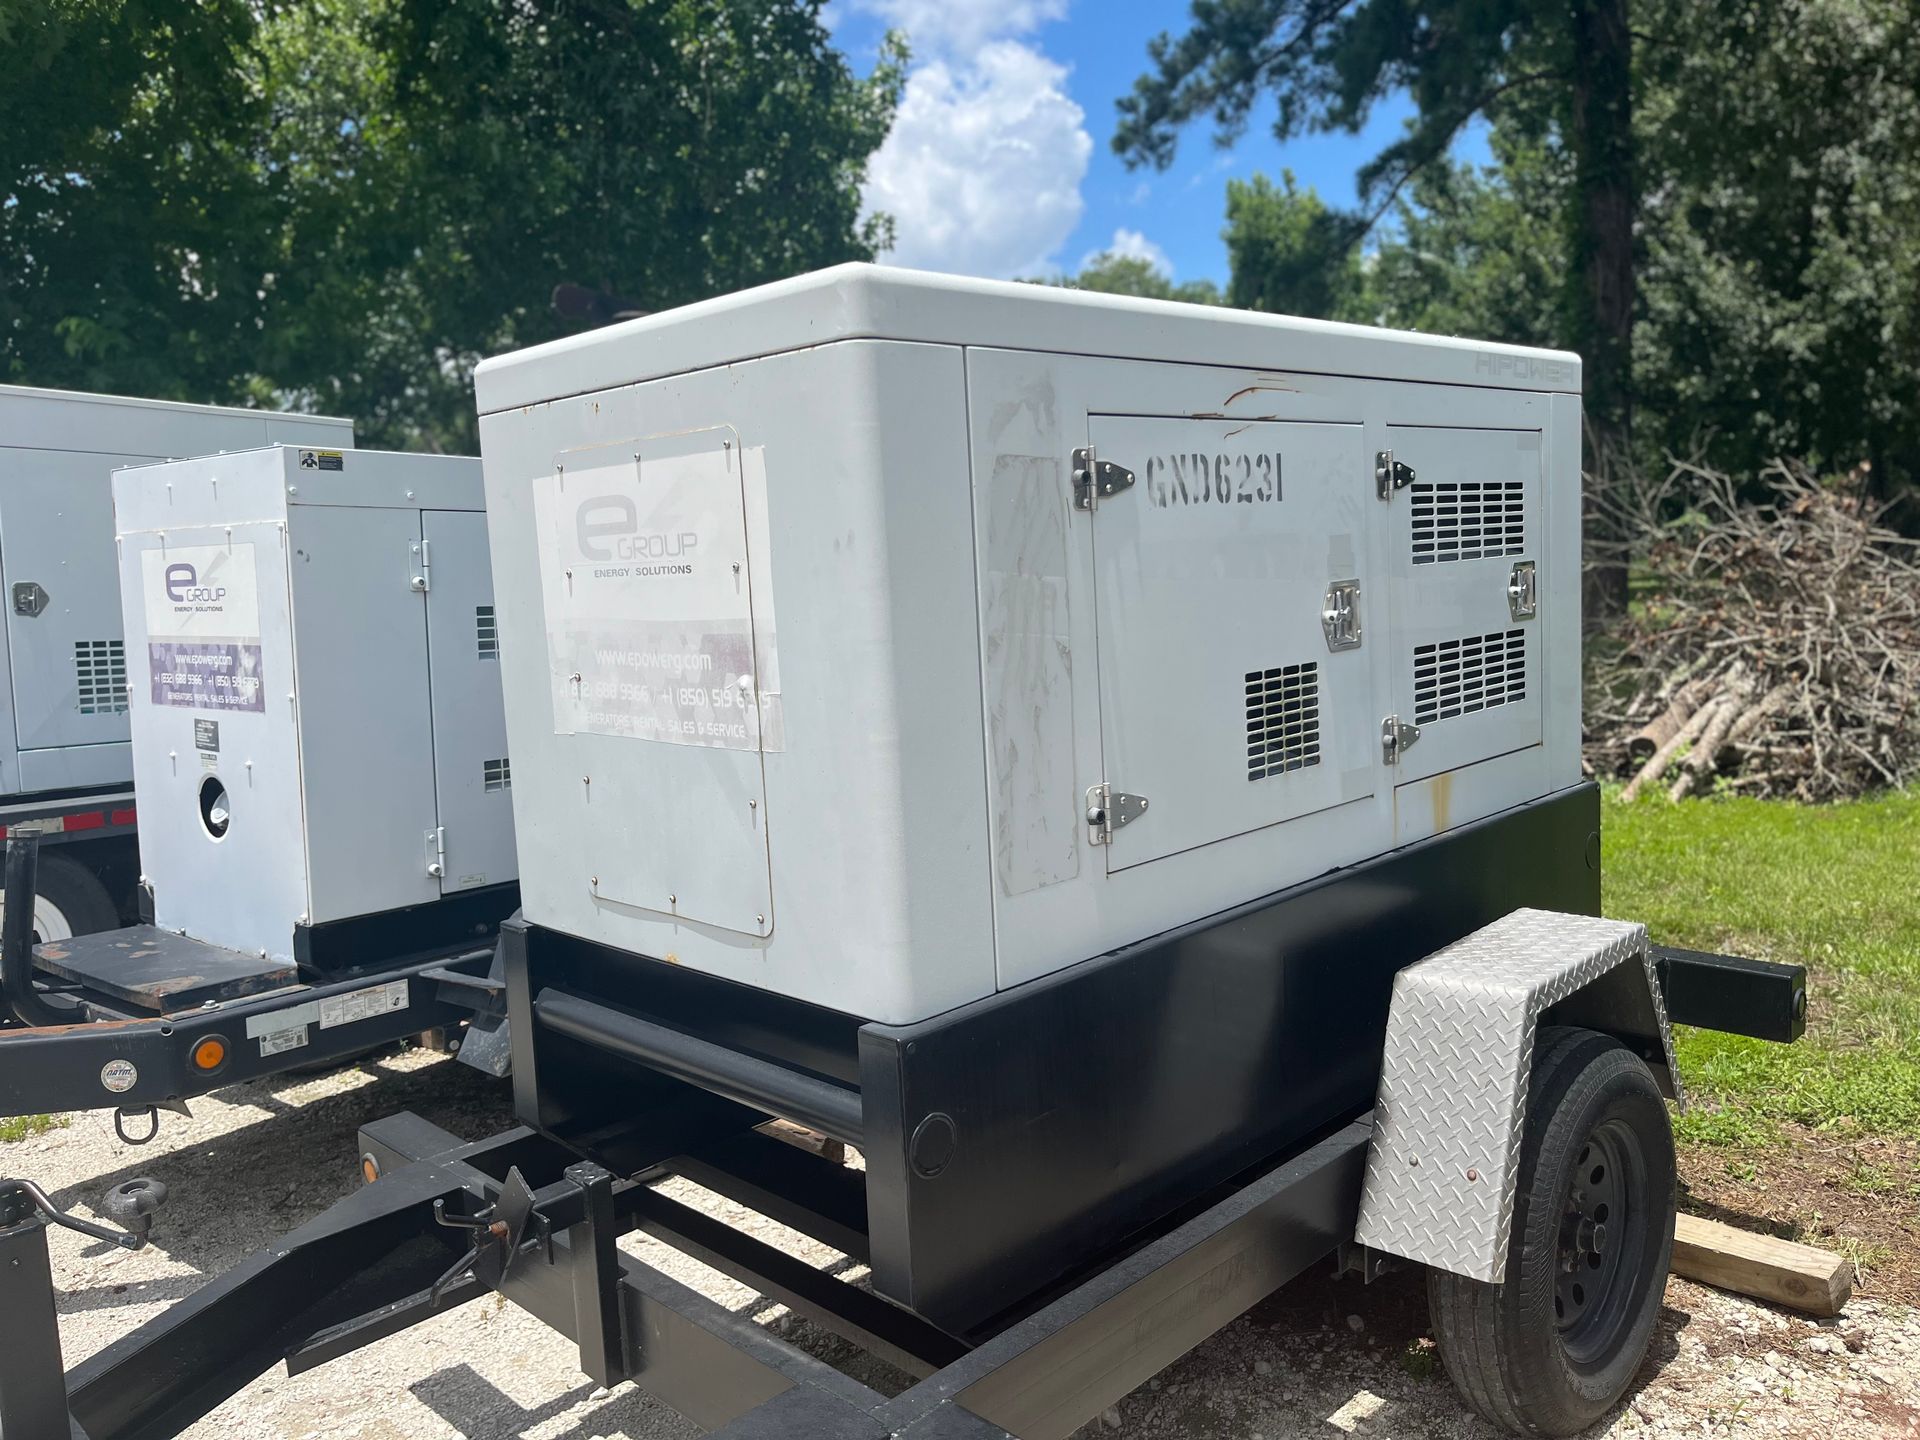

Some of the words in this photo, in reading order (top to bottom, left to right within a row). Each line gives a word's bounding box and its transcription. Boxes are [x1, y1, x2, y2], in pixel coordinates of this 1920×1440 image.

[1146, 453, 1283, 508] GND6231
[576, 494, 637, 561] e
[617, 532, 698, 560] GROUP
[165, 563, 197, 602] e
[186, 588, 226, 602] GROUP
[594, 568, 630, 578] ENERGY
[635, 565, 692, 577] SOLUTIONS
[595, 650, 711, 674] www.epowerg.com
[706, 722, 745, 738] SERVICE
